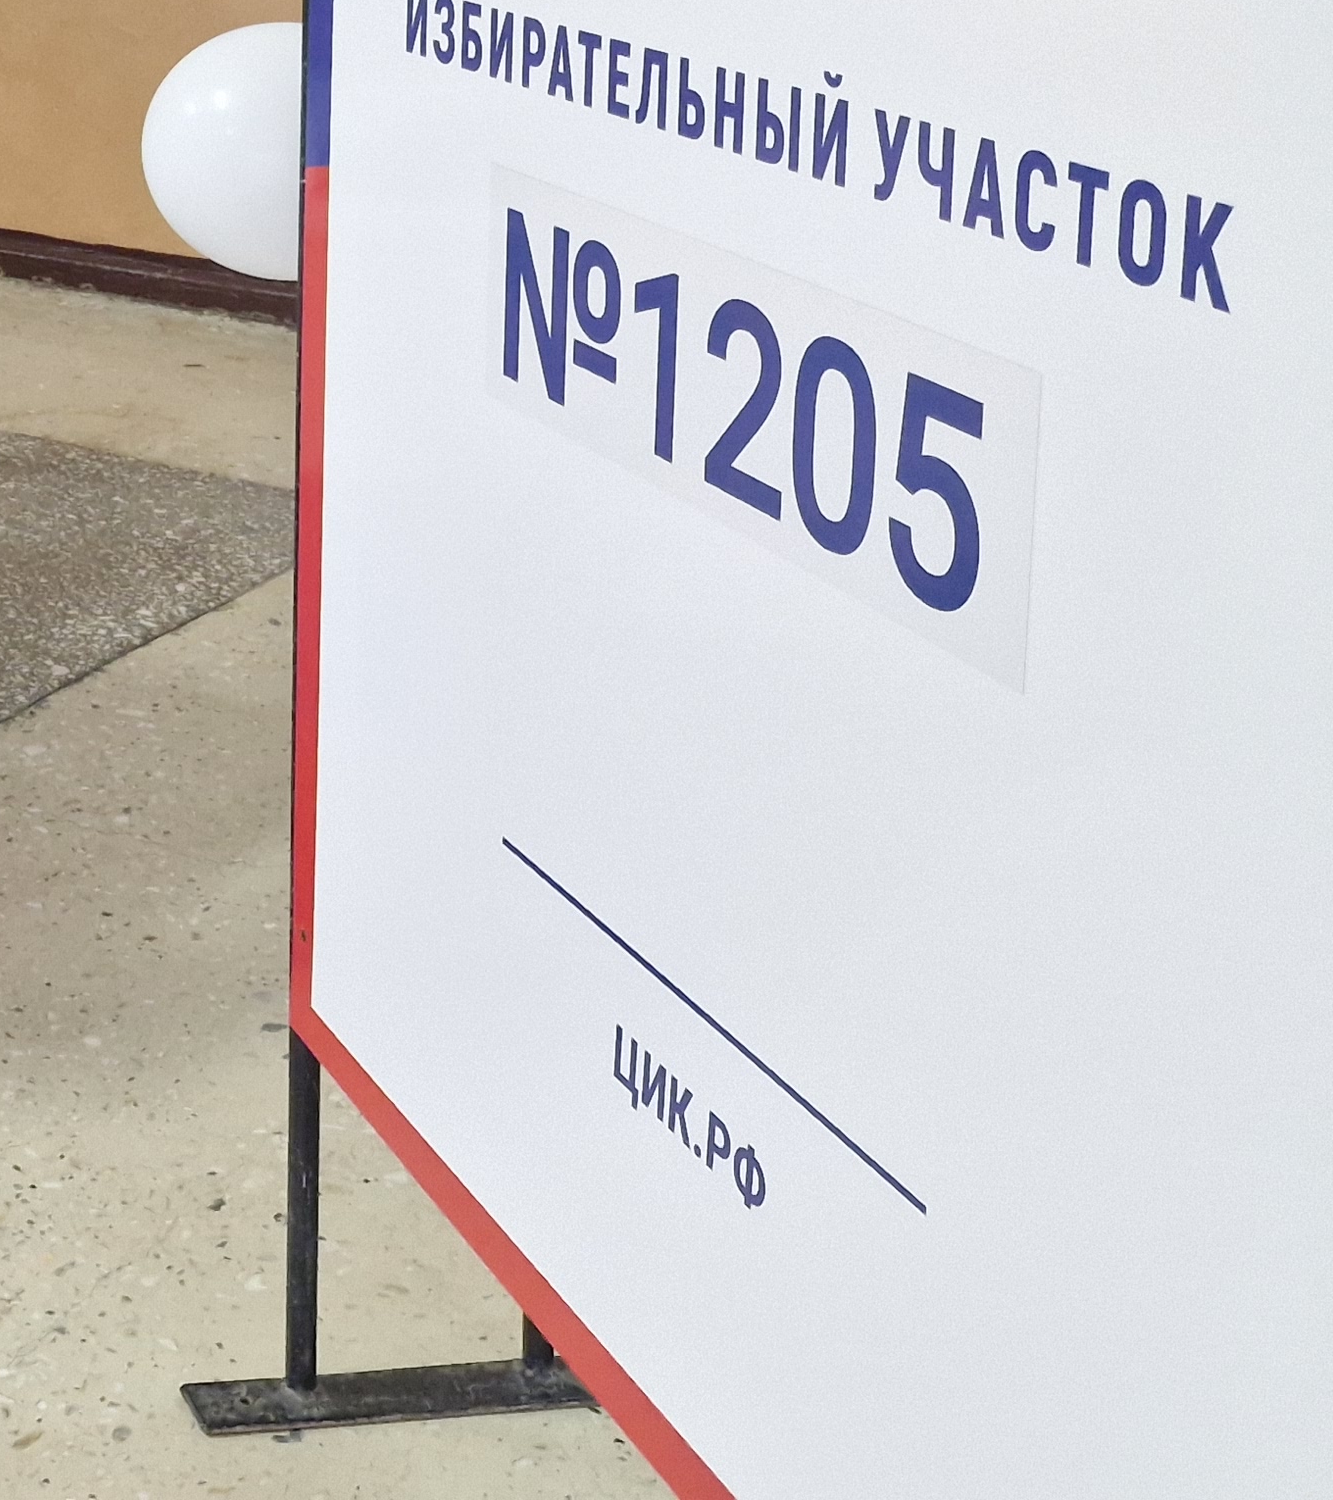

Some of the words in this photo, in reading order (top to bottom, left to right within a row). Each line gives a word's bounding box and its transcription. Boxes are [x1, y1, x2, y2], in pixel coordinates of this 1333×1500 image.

[873, 107, 1234, 314] УЧАСТОК
[502, 206, 986, 613] №1205
[613, 1023, 766, 1210] ЦИК.РФ
